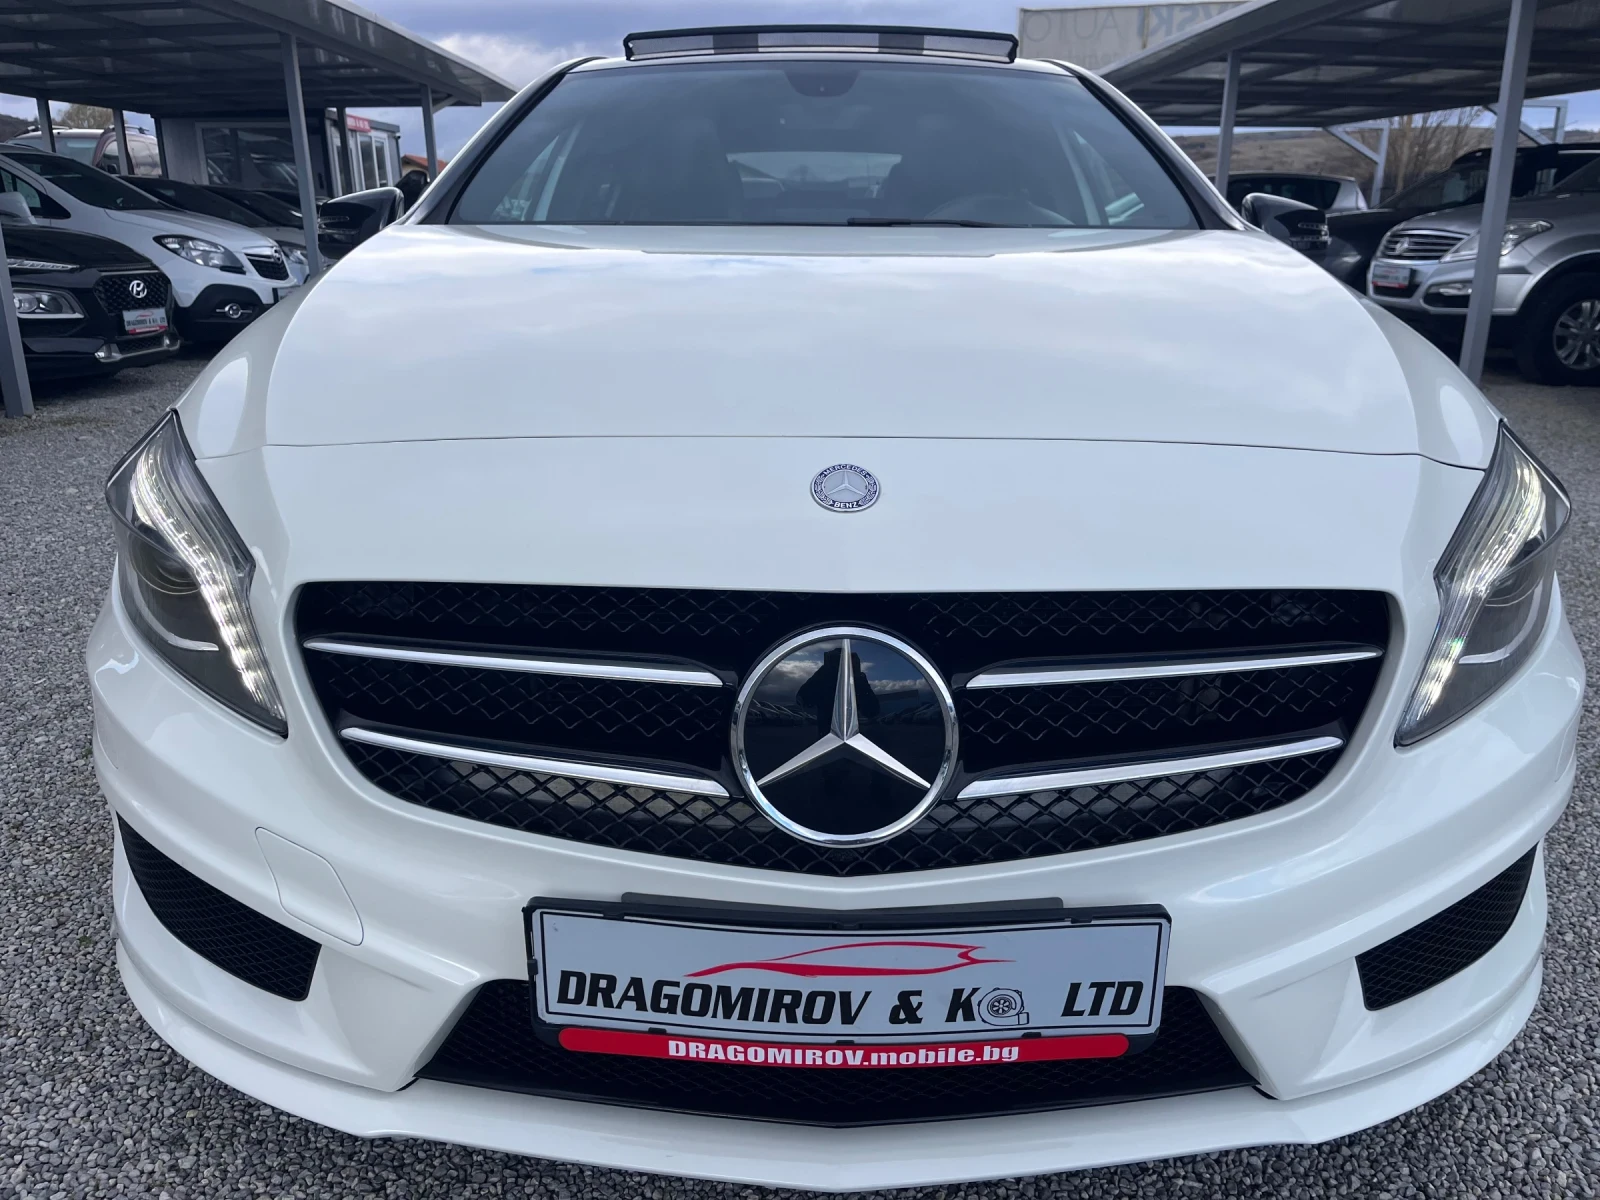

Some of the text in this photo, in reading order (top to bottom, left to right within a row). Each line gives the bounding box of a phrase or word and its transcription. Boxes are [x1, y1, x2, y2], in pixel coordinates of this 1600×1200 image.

[822, 464, 867, 476] MERCEDES
[833, 501, 859, 509] BENZ
[556, 969, 873, 1026] DRAGOMIROV
[888, 990, 924, 1025] &
[1060, 980, 1144, 1018] LTD
[668, 1040, 1020, 1066] DRAGOMIROV.mobile.bg
